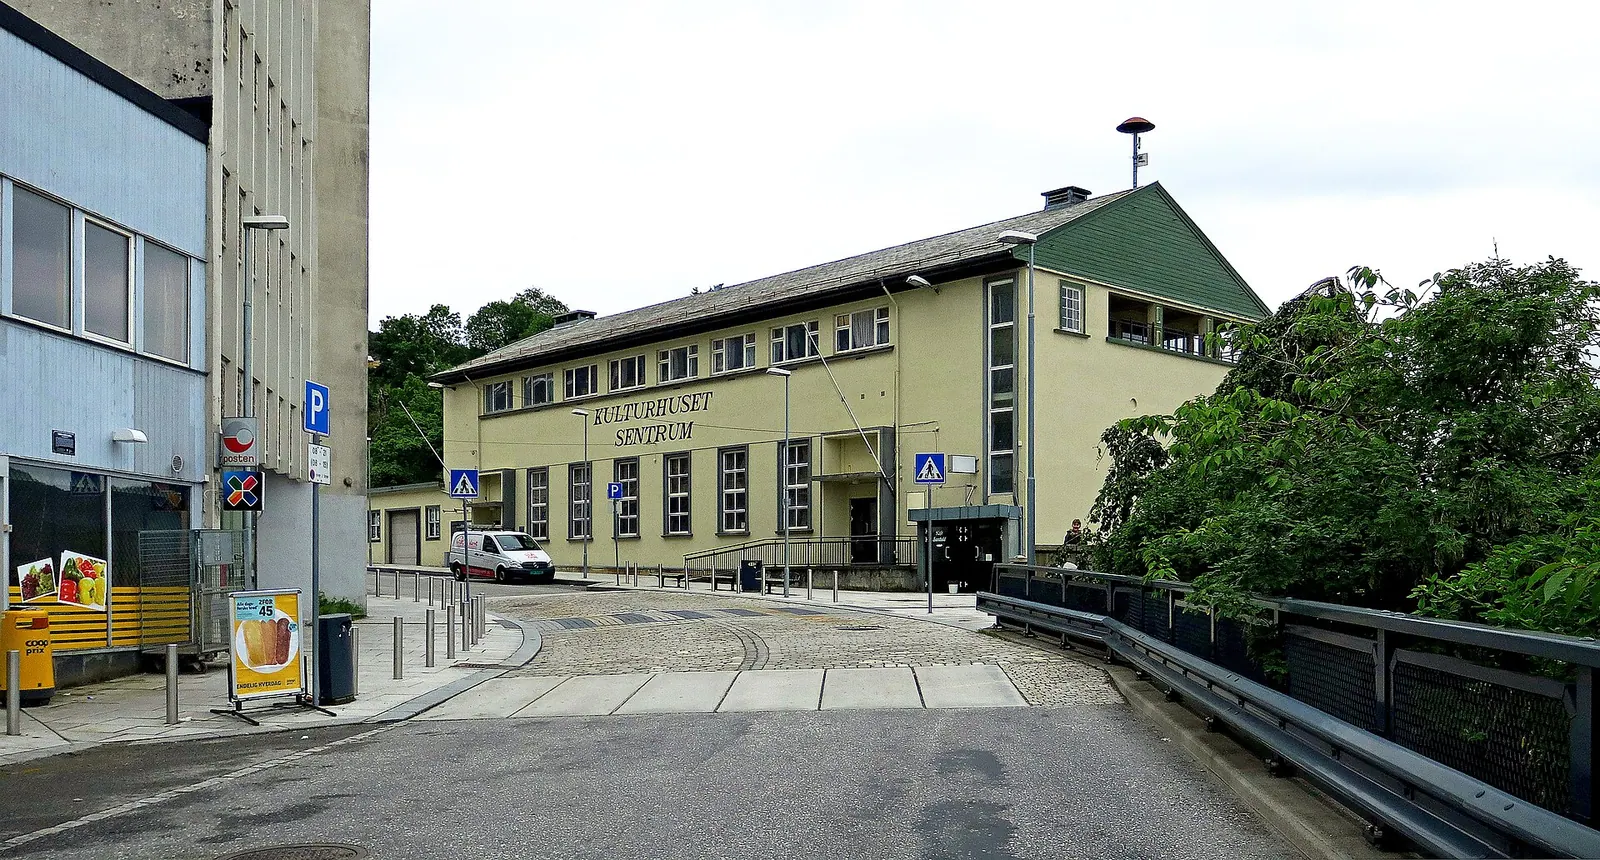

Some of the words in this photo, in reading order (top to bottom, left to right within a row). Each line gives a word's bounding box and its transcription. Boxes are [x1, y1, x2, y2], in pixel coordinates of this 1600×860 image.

[311, 389, 324, 425] P
[593, 391, 713, 426] KULTURHUSET
[614, 421, 694, 447] SENTRUM
[223, 455, 255, 464] posten
[611, 484, 620, 497] P
[259, 605, 273, 616] 45
[25, 640, 48, 649] coop
[26, 647, 45, 656] prix
